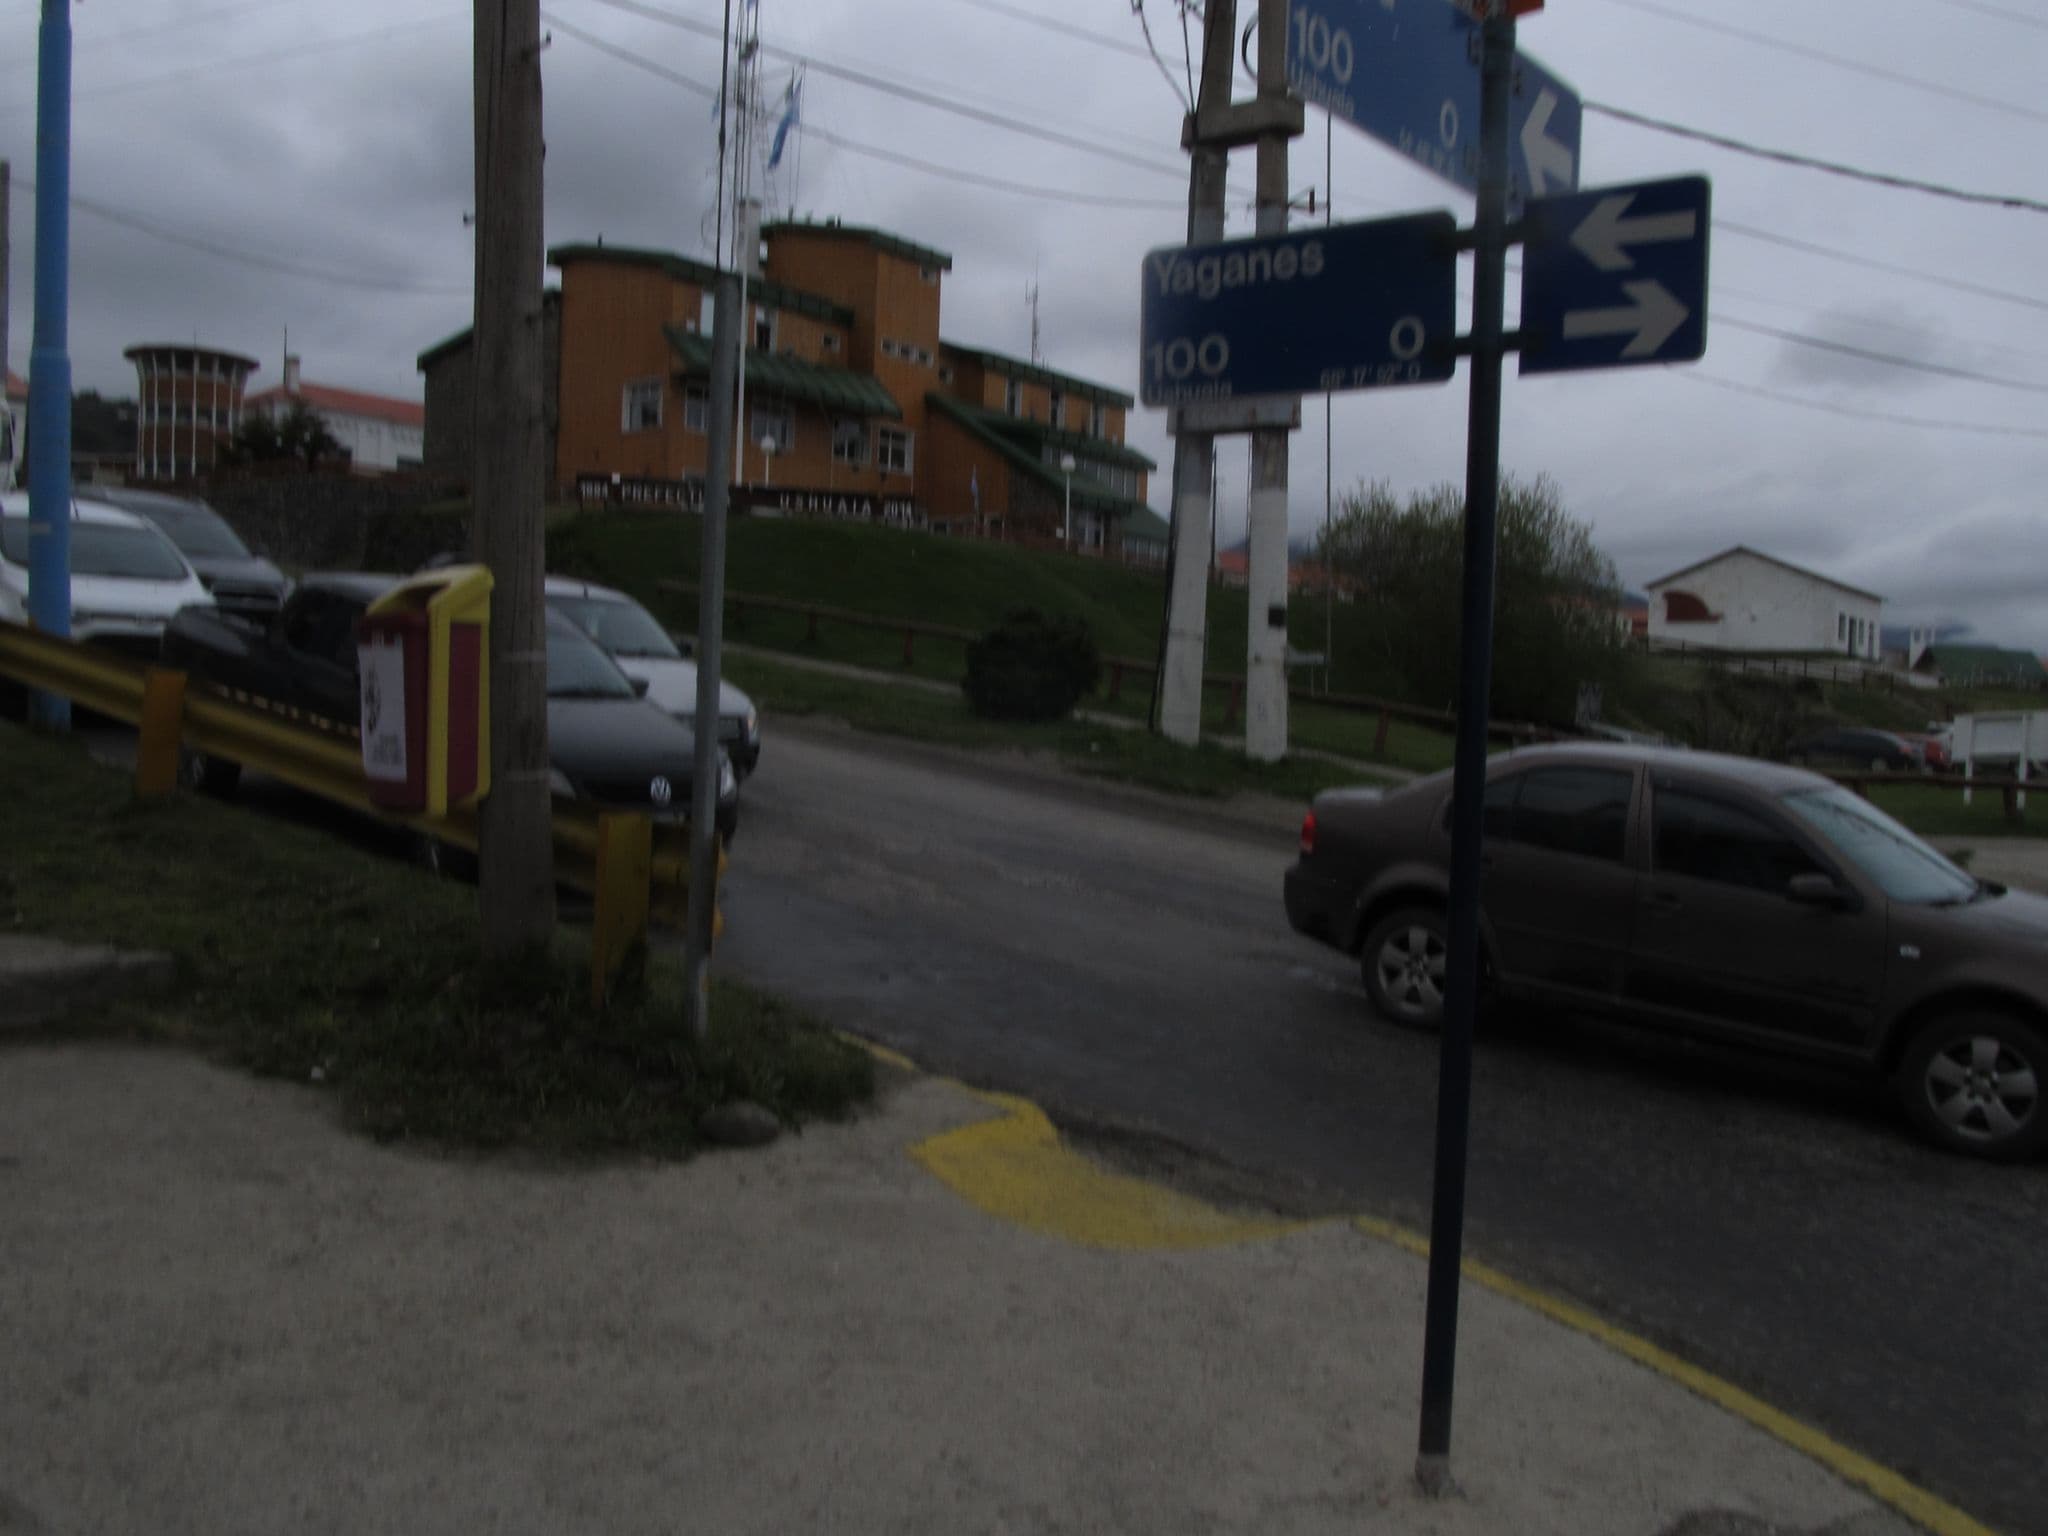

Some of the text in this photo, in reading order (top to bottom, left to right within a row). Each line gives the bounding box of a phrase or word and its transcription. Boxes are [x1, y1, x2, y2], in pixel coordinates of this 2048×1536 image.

[1293, 5, 1354, 85] 100
[1153, 239, 1326, 302] Yaganes
[1148, 332, 1230, 383] 100
